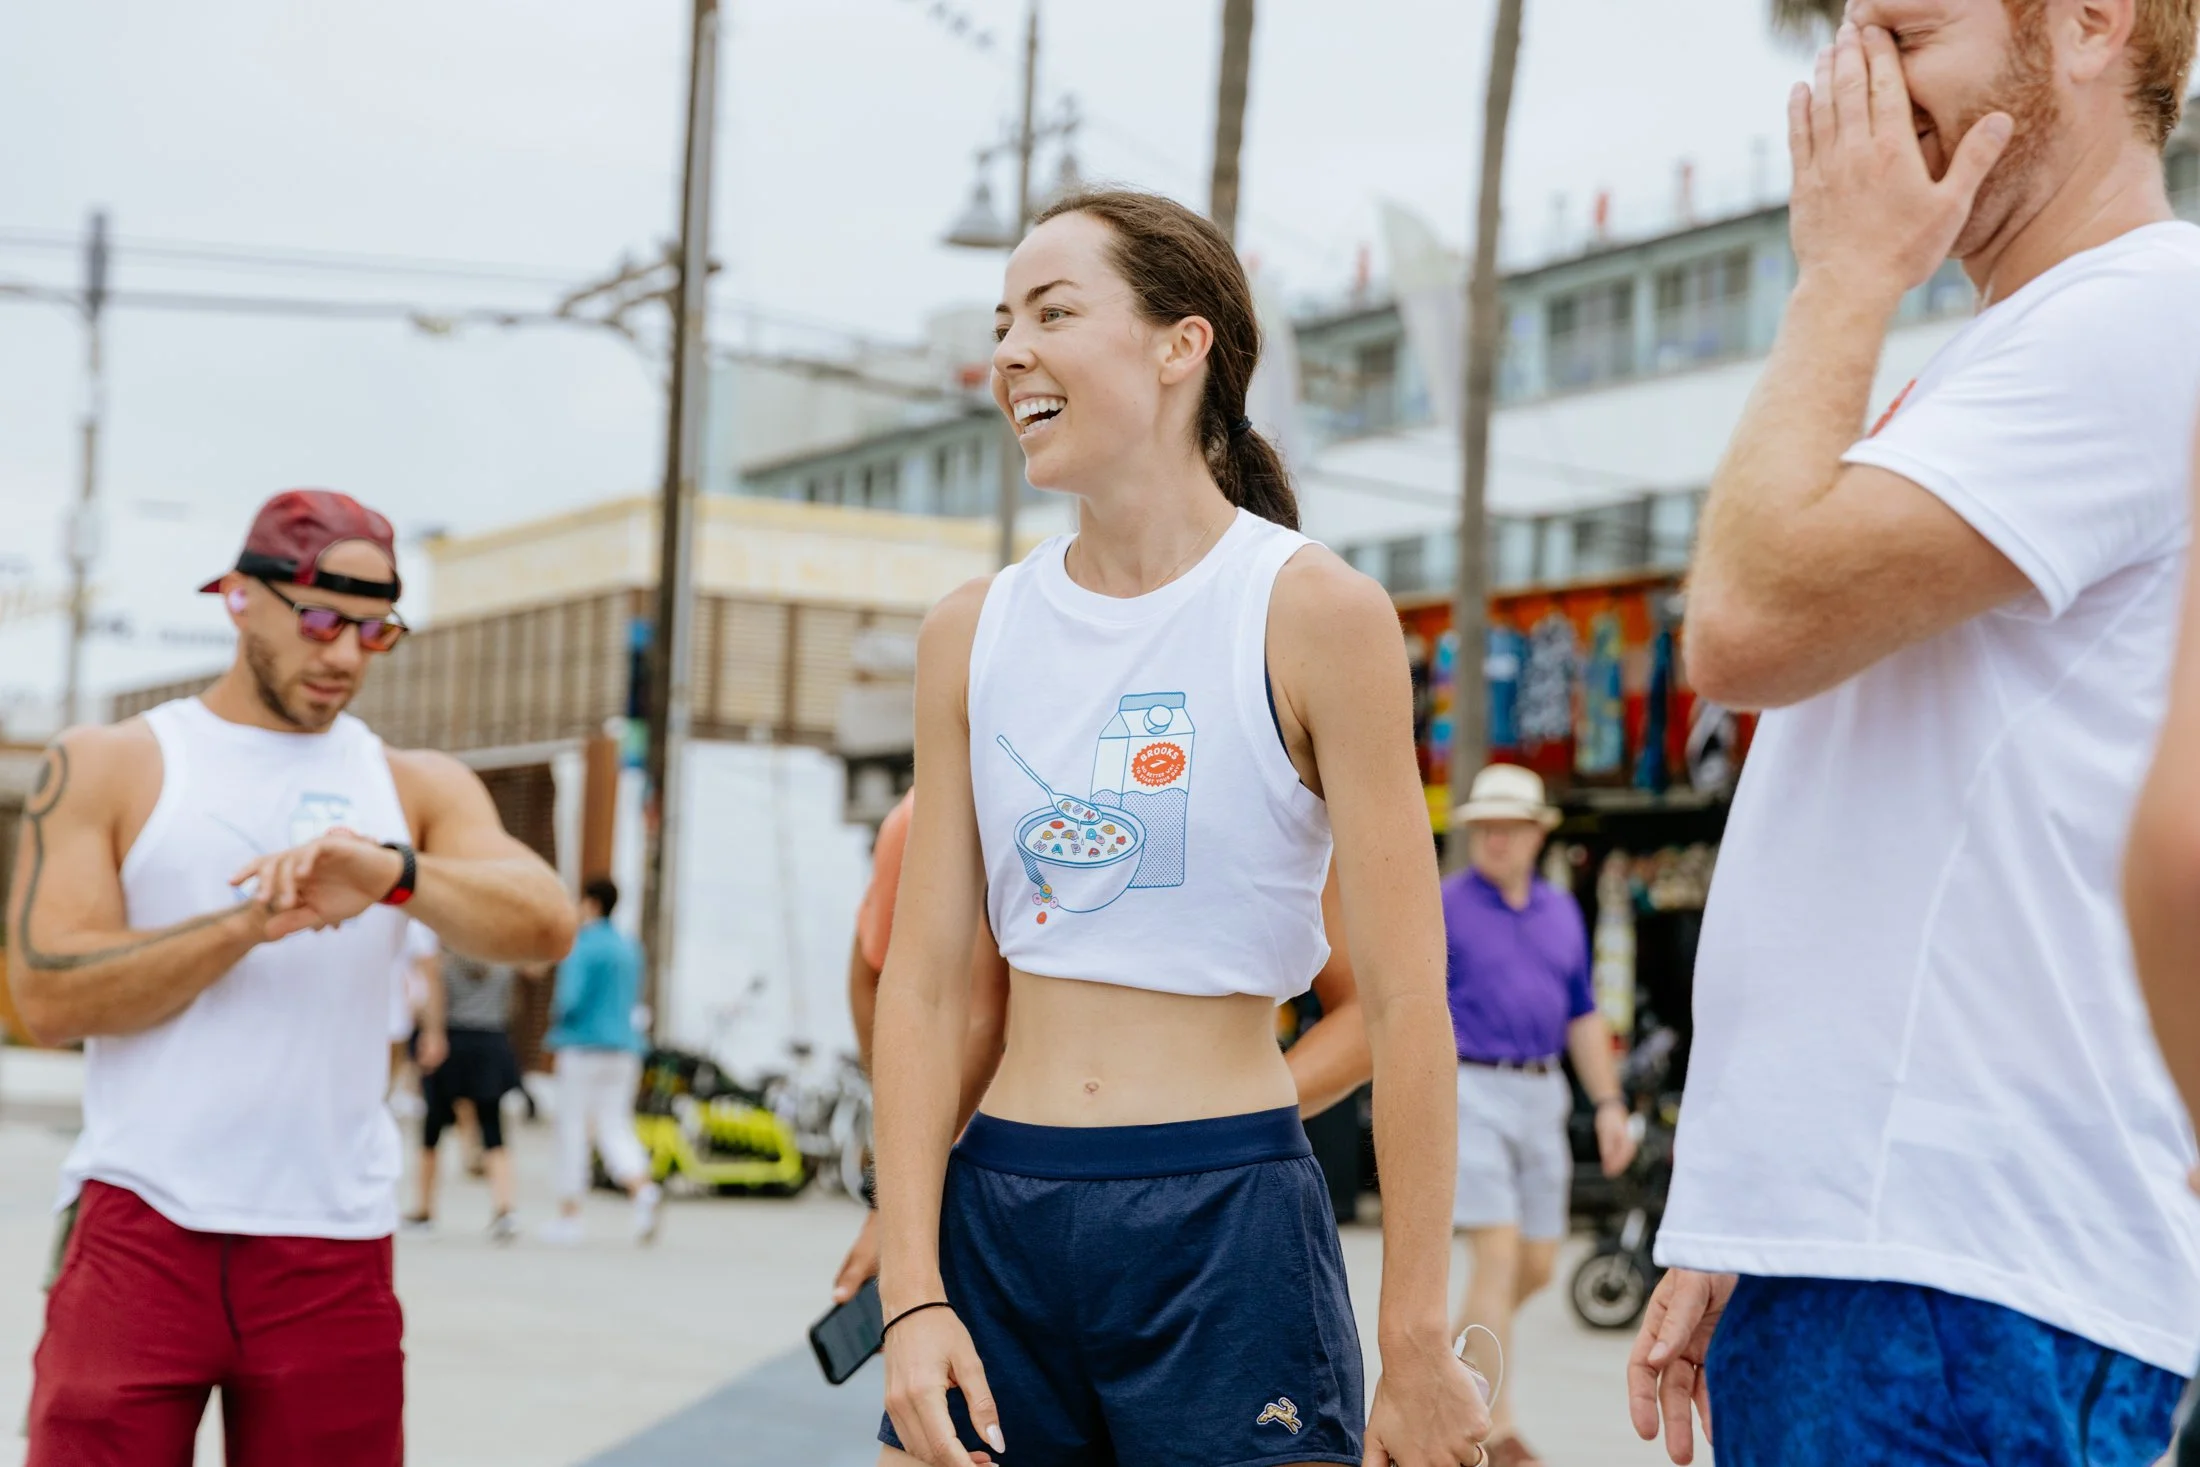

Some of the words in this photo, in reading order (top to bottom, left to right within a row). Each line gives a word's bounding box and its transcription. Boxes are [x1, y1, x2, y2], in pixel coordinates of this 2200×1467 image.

[1140, 746, 1179, 762] BROOKS
[1136, 766, 1141, 774] TO
[1139, 774, 1155, 783] START
[1141, 765, 1147, 773] NO
[1165, 764, 1175, 774] WAY
